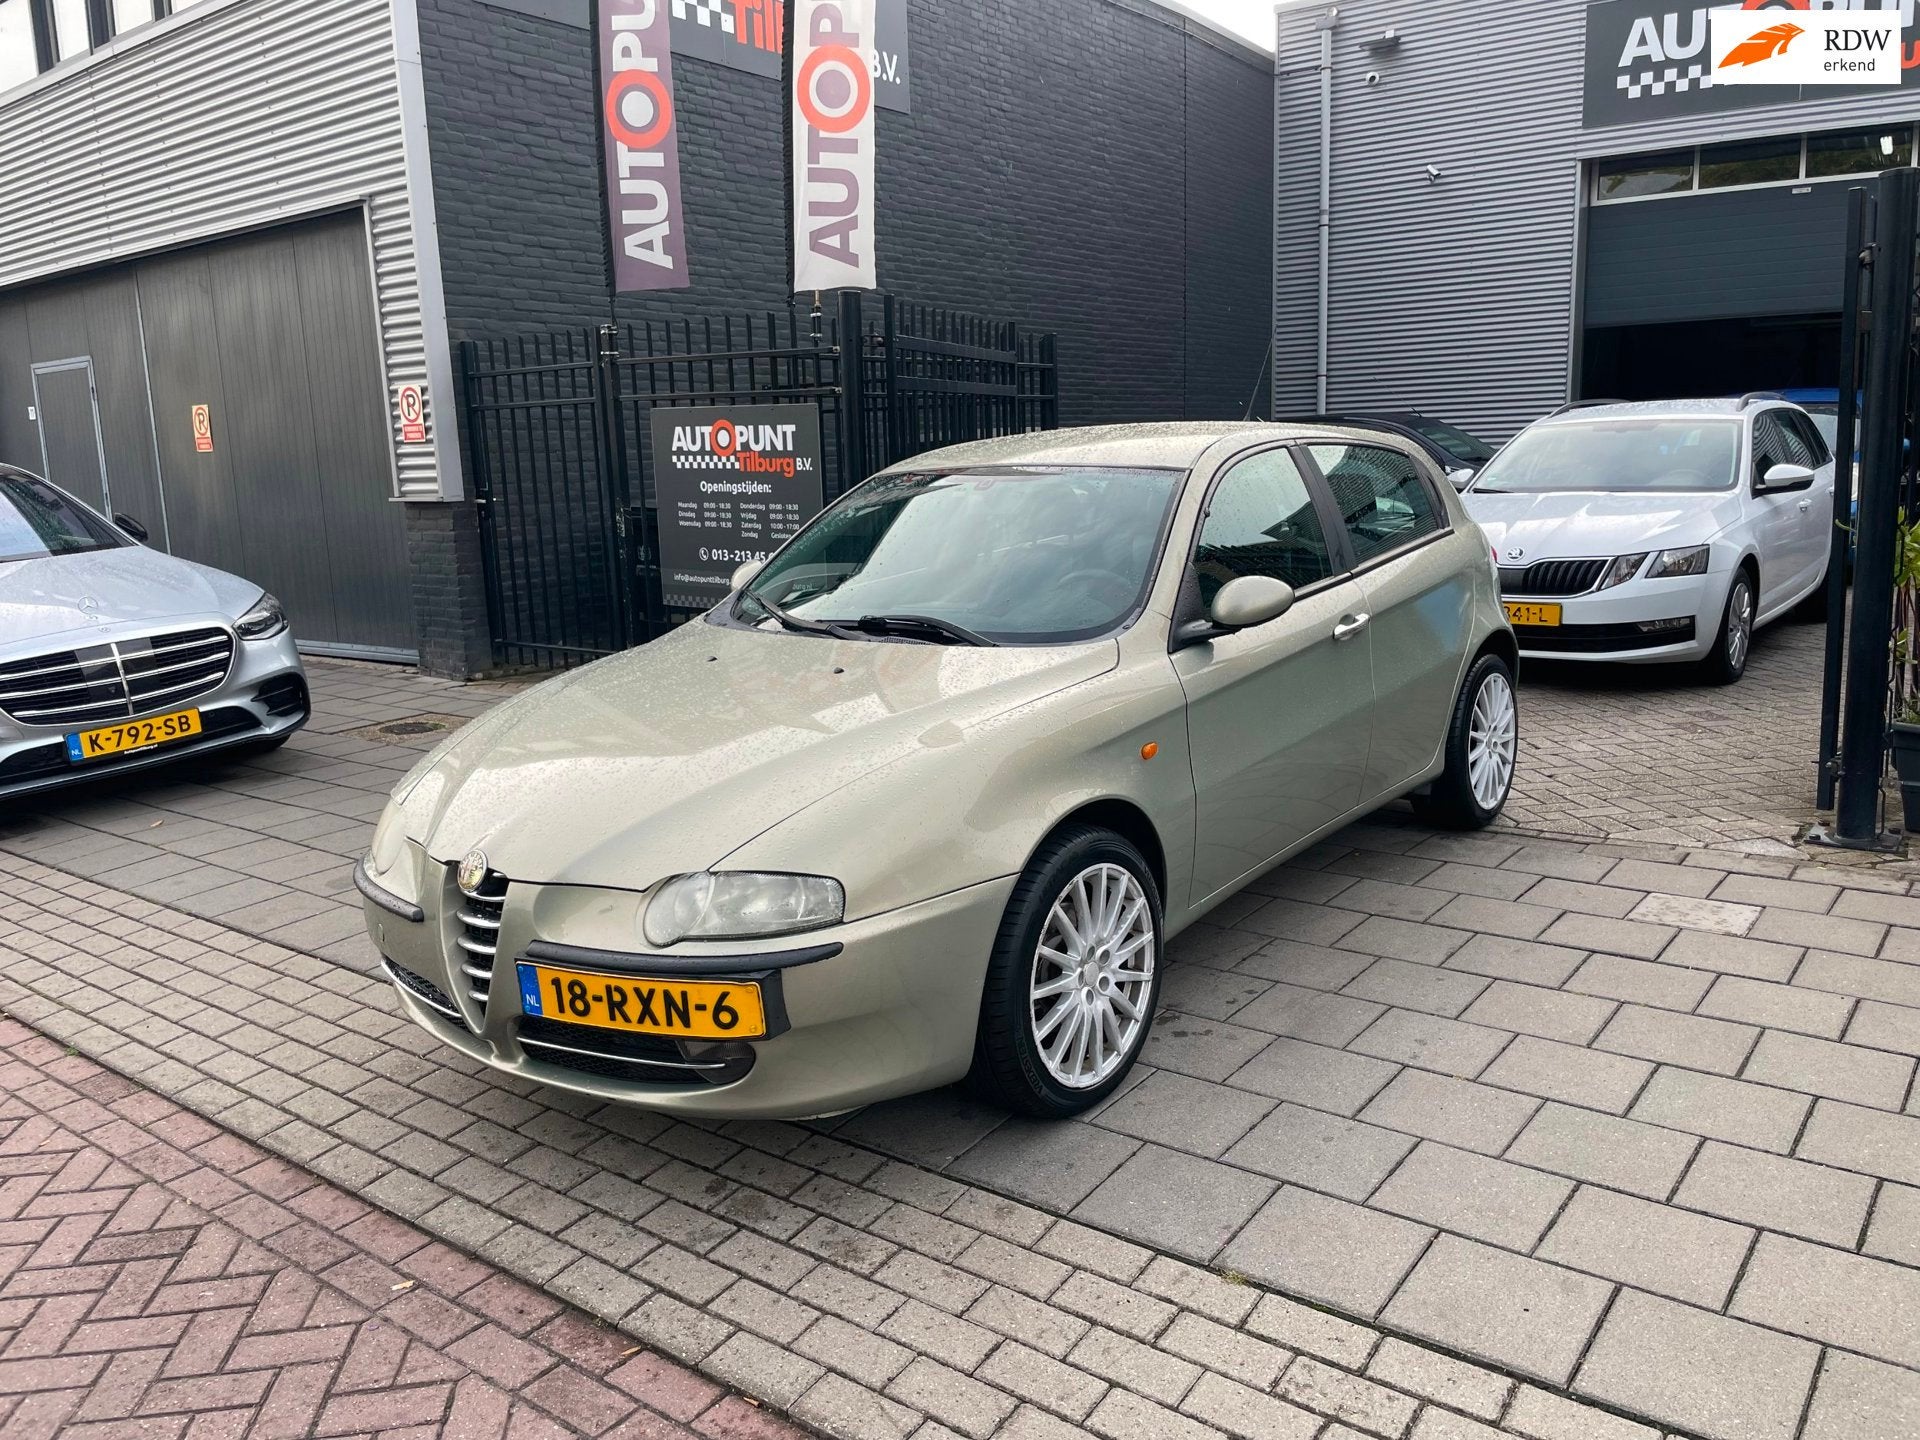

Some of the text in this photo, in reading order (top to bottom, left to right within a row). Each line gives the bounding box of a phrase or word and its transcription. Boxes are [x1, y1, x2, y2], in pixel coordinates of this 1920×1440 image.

[671, 419, 796, 457] AUTOPUNT
[736, 451, 813, 478] Tilburg B.V.
[699, 480, 772, 495] Openingstijden:
[739, 502, 766, 511] Donderdag
[785, 503, 799, 511] 18:30
[740, 512, 757, 520] Vrijdag
[785, 513, 800, 521] 18:30
[754, 550, 766, 562] 45
[88, 714, 191, 753] K-792-SB
[525, 976, 739, 1030] NL 18-RXN-6
